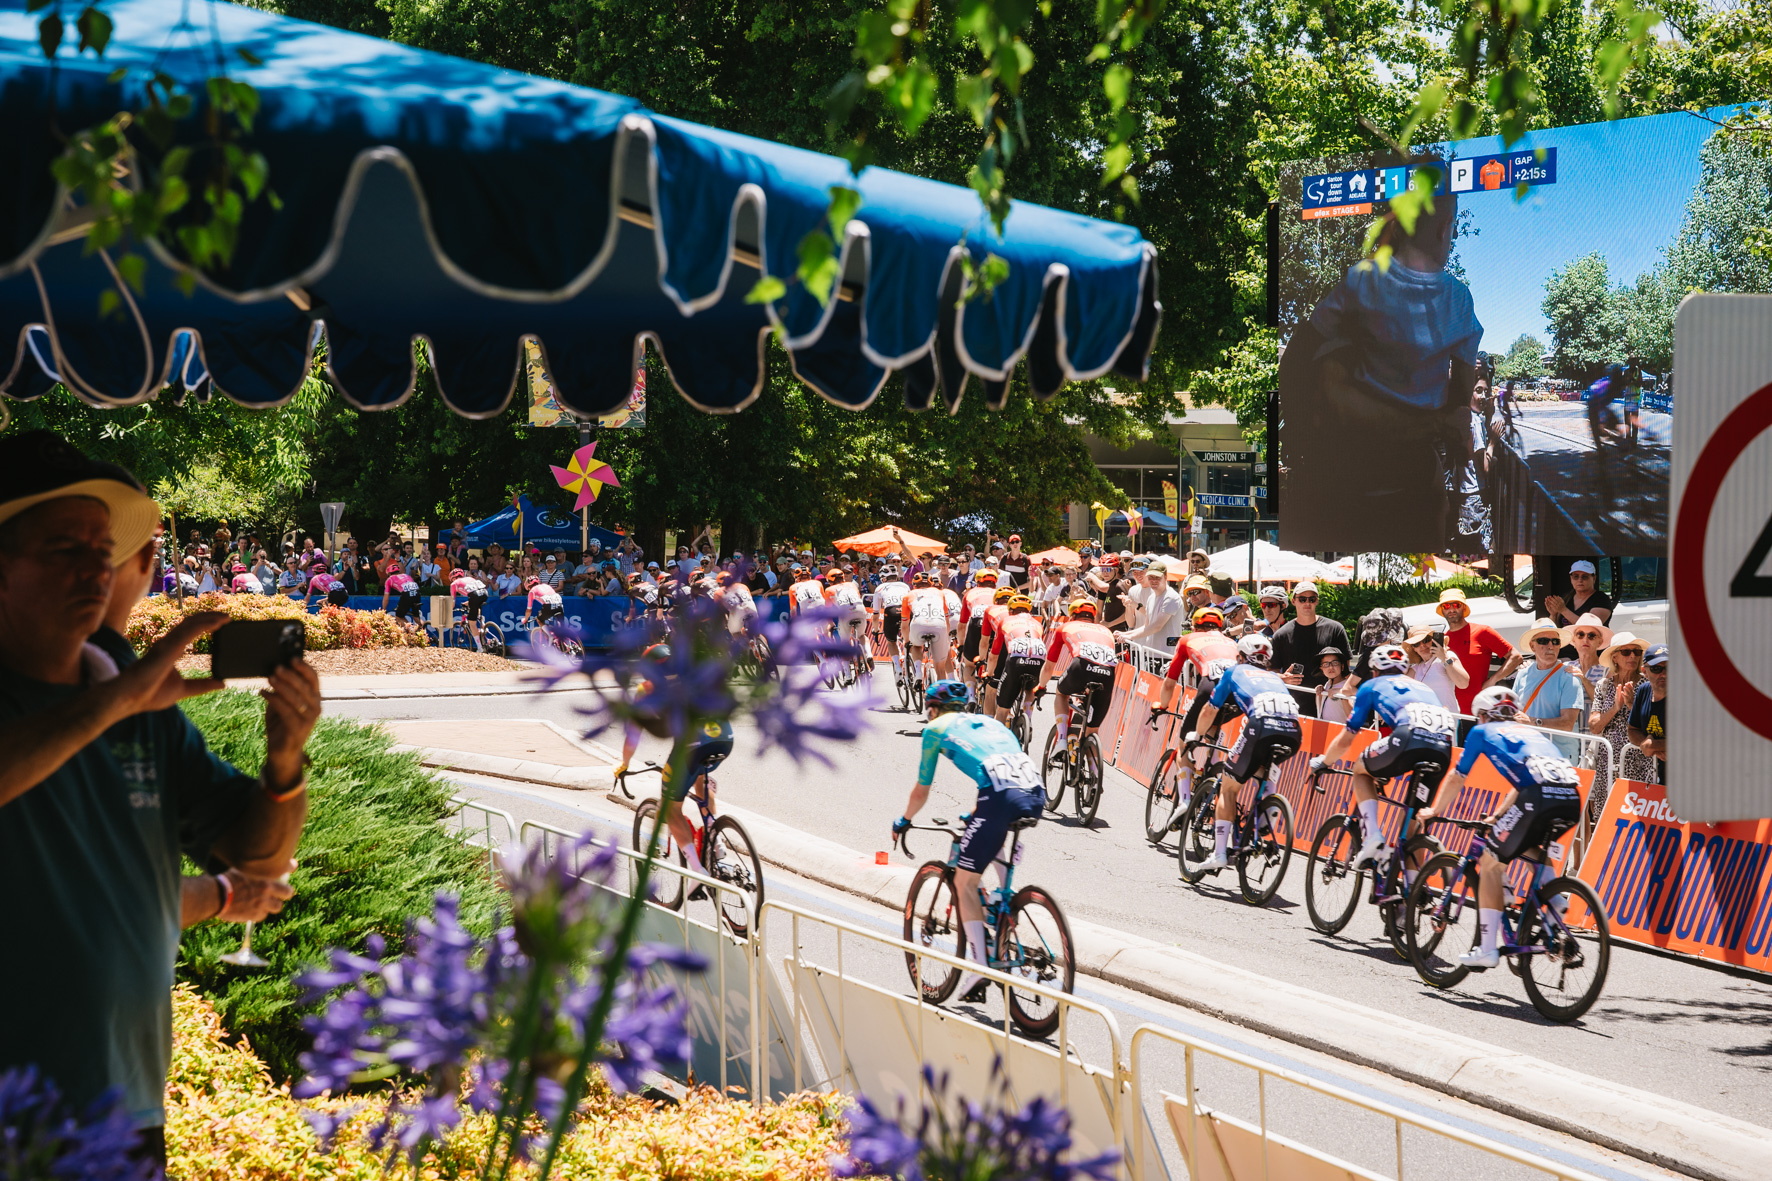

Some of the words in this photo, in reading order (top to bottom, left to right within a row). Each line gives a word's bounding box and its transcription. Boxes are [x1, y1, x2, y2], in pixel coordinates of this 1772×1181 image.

[1514, 156, 1533, 166] GAP
[1457, 168, 1467, 182] P
[1391, 174, 1399, 191] 1
[1332, 206, 1355, 215] STAGE
[1202, 452, 1237, 462] JOHNSTON
[1201, 495, 1226, 505] MEDICAL
[1227, 496, 1246, 506] CLINIC
[500, 611, 582, 633] Saos
[1584, 817, 1683, 932] TOUR
